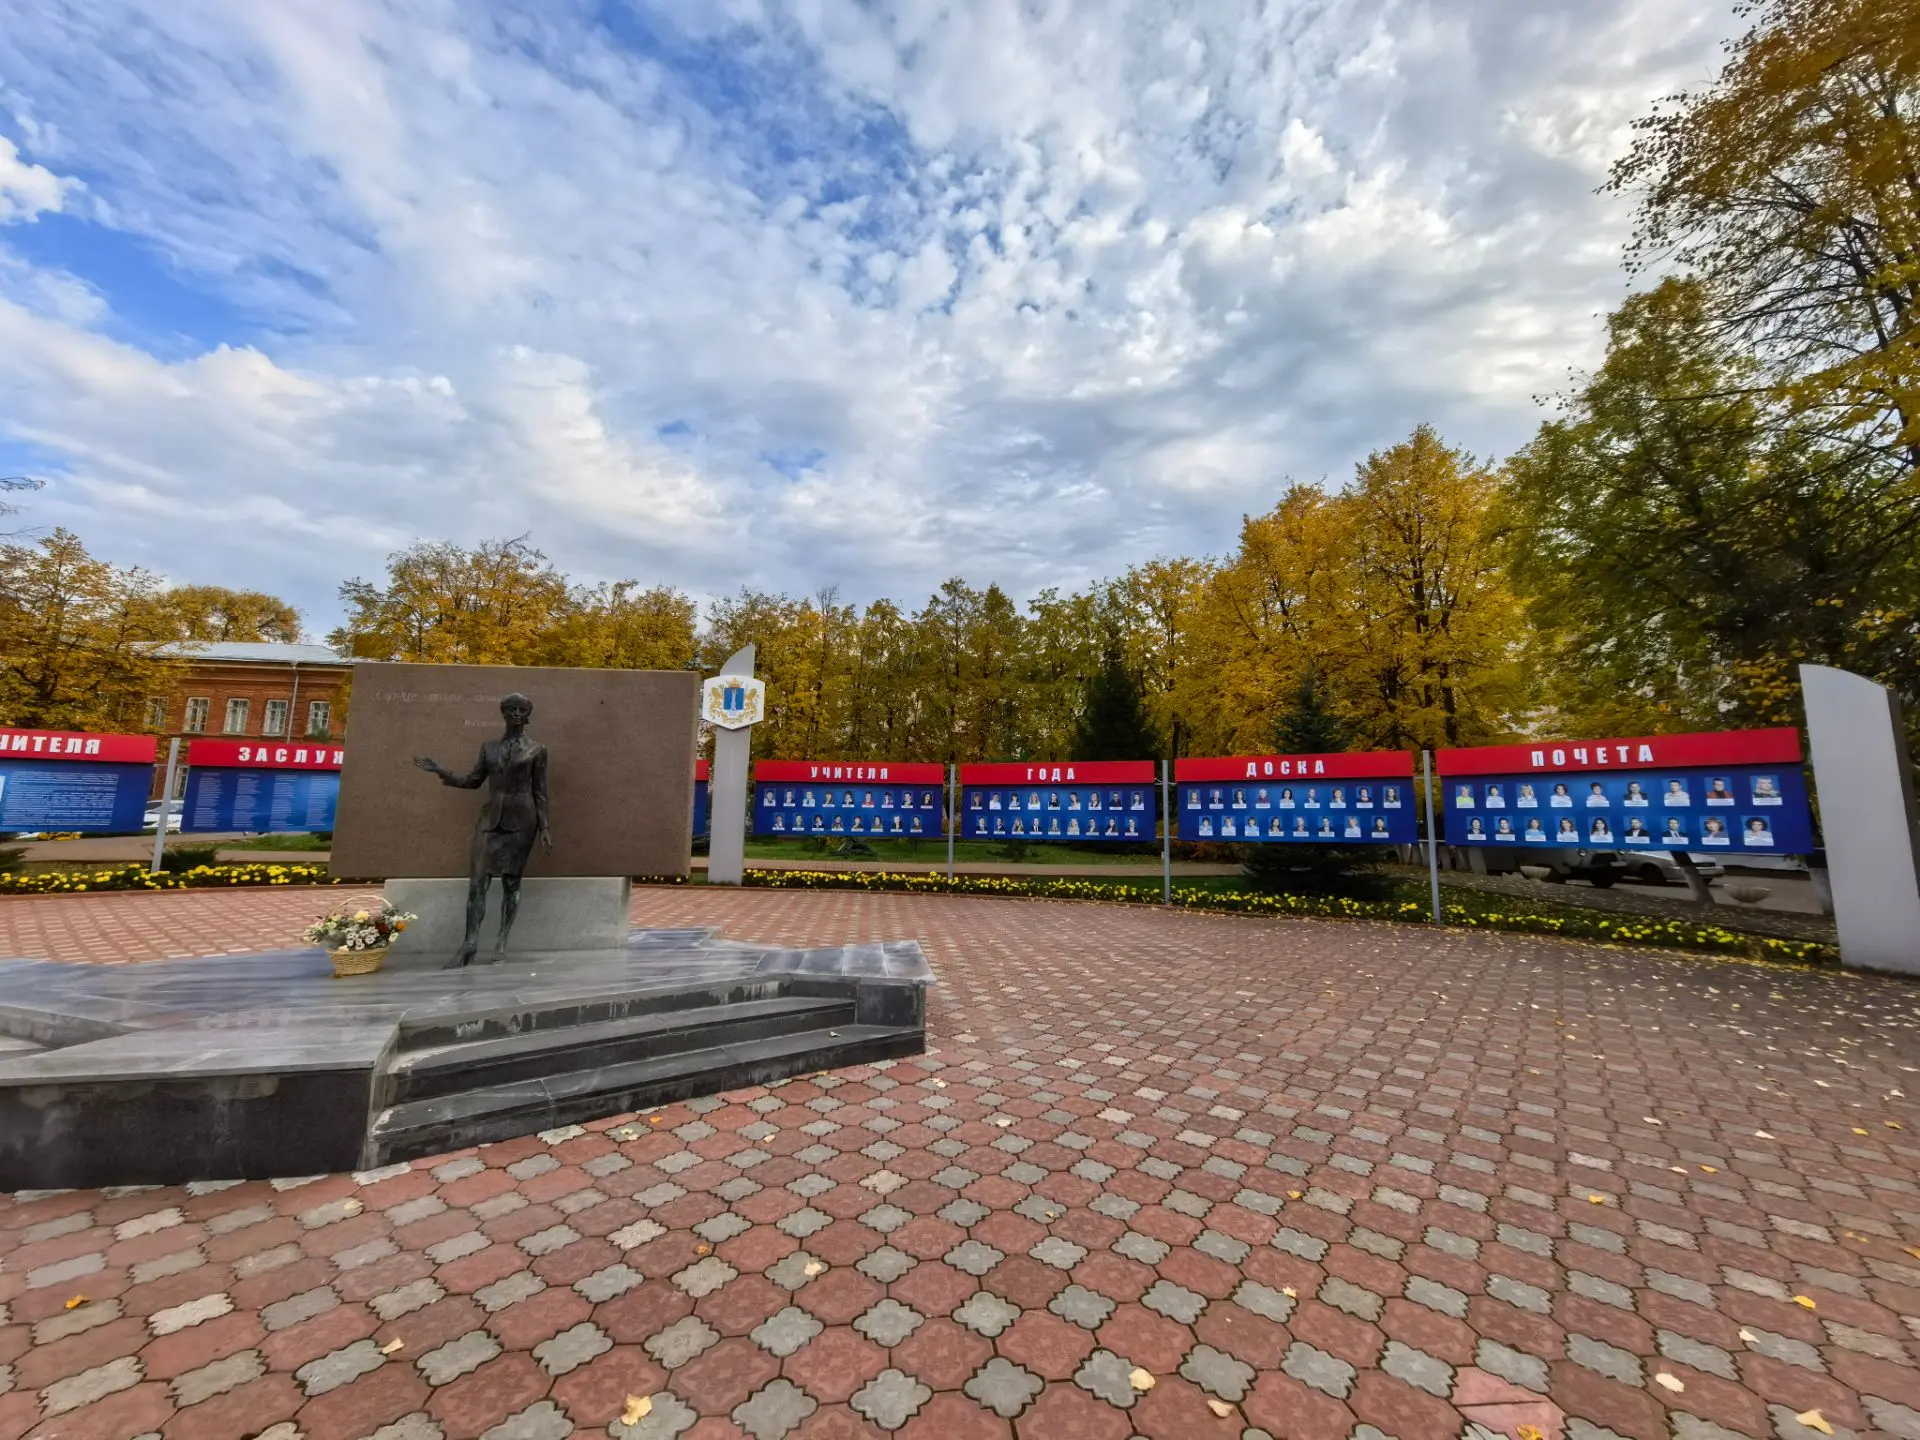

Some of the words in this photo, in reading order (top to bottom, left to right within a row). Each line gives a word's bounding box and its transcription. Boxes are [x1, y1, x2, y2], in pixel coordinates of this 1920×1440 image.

[1531, 744, 1654, 767] ПОЧЕТА
[811, 766, 888, 779] УЧИТЕЛЯ
[1027, 768, 1075, 782] ГОДА
[1246, 760, 1325, 778] ДОСКА
